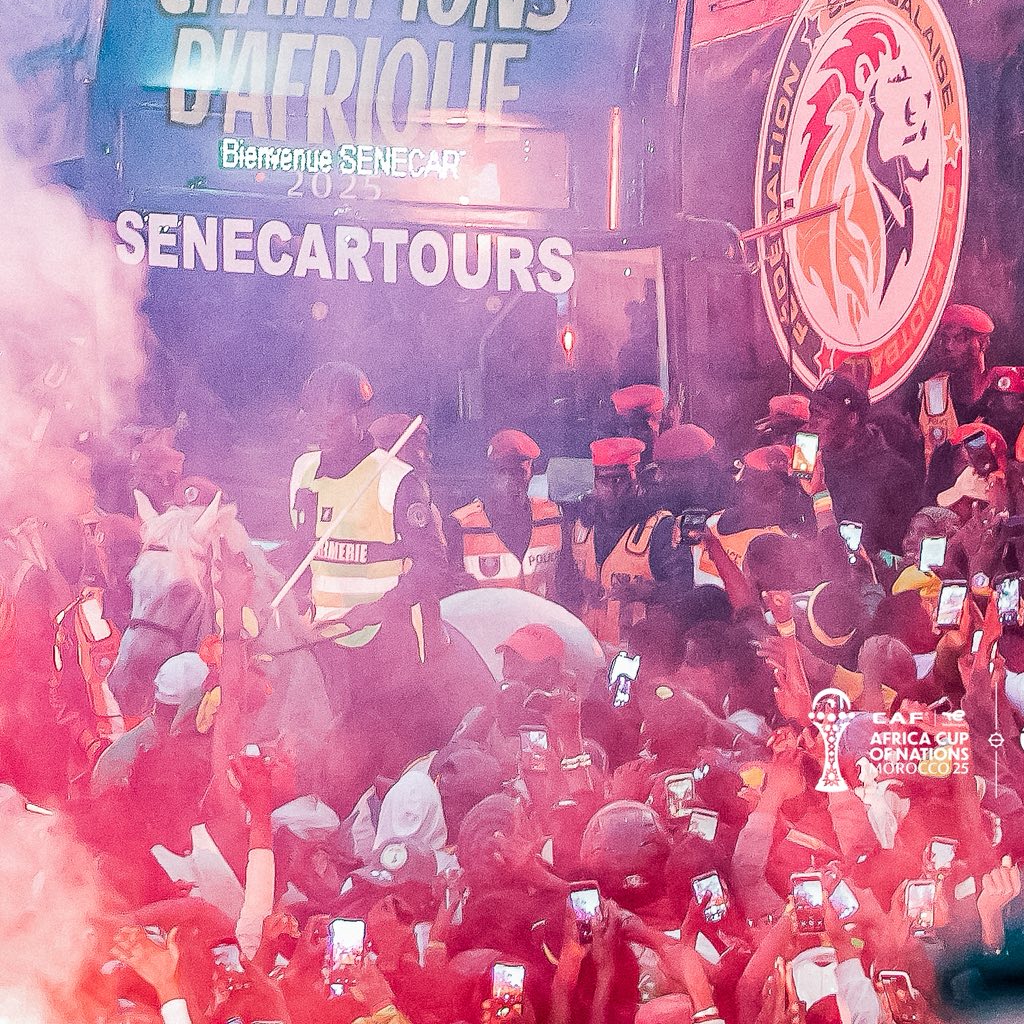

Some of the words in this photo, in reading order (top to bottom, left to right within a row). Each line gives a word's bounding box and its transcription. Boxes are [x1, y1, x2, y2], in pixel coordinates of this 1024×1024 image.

[221, 138, 332, 173] Bienvenue
[287, 175, 383, 201] 2025
[115, 209, 576, 295] SENECARTOURS
[870, 257, 945, 377] FOOTBA
